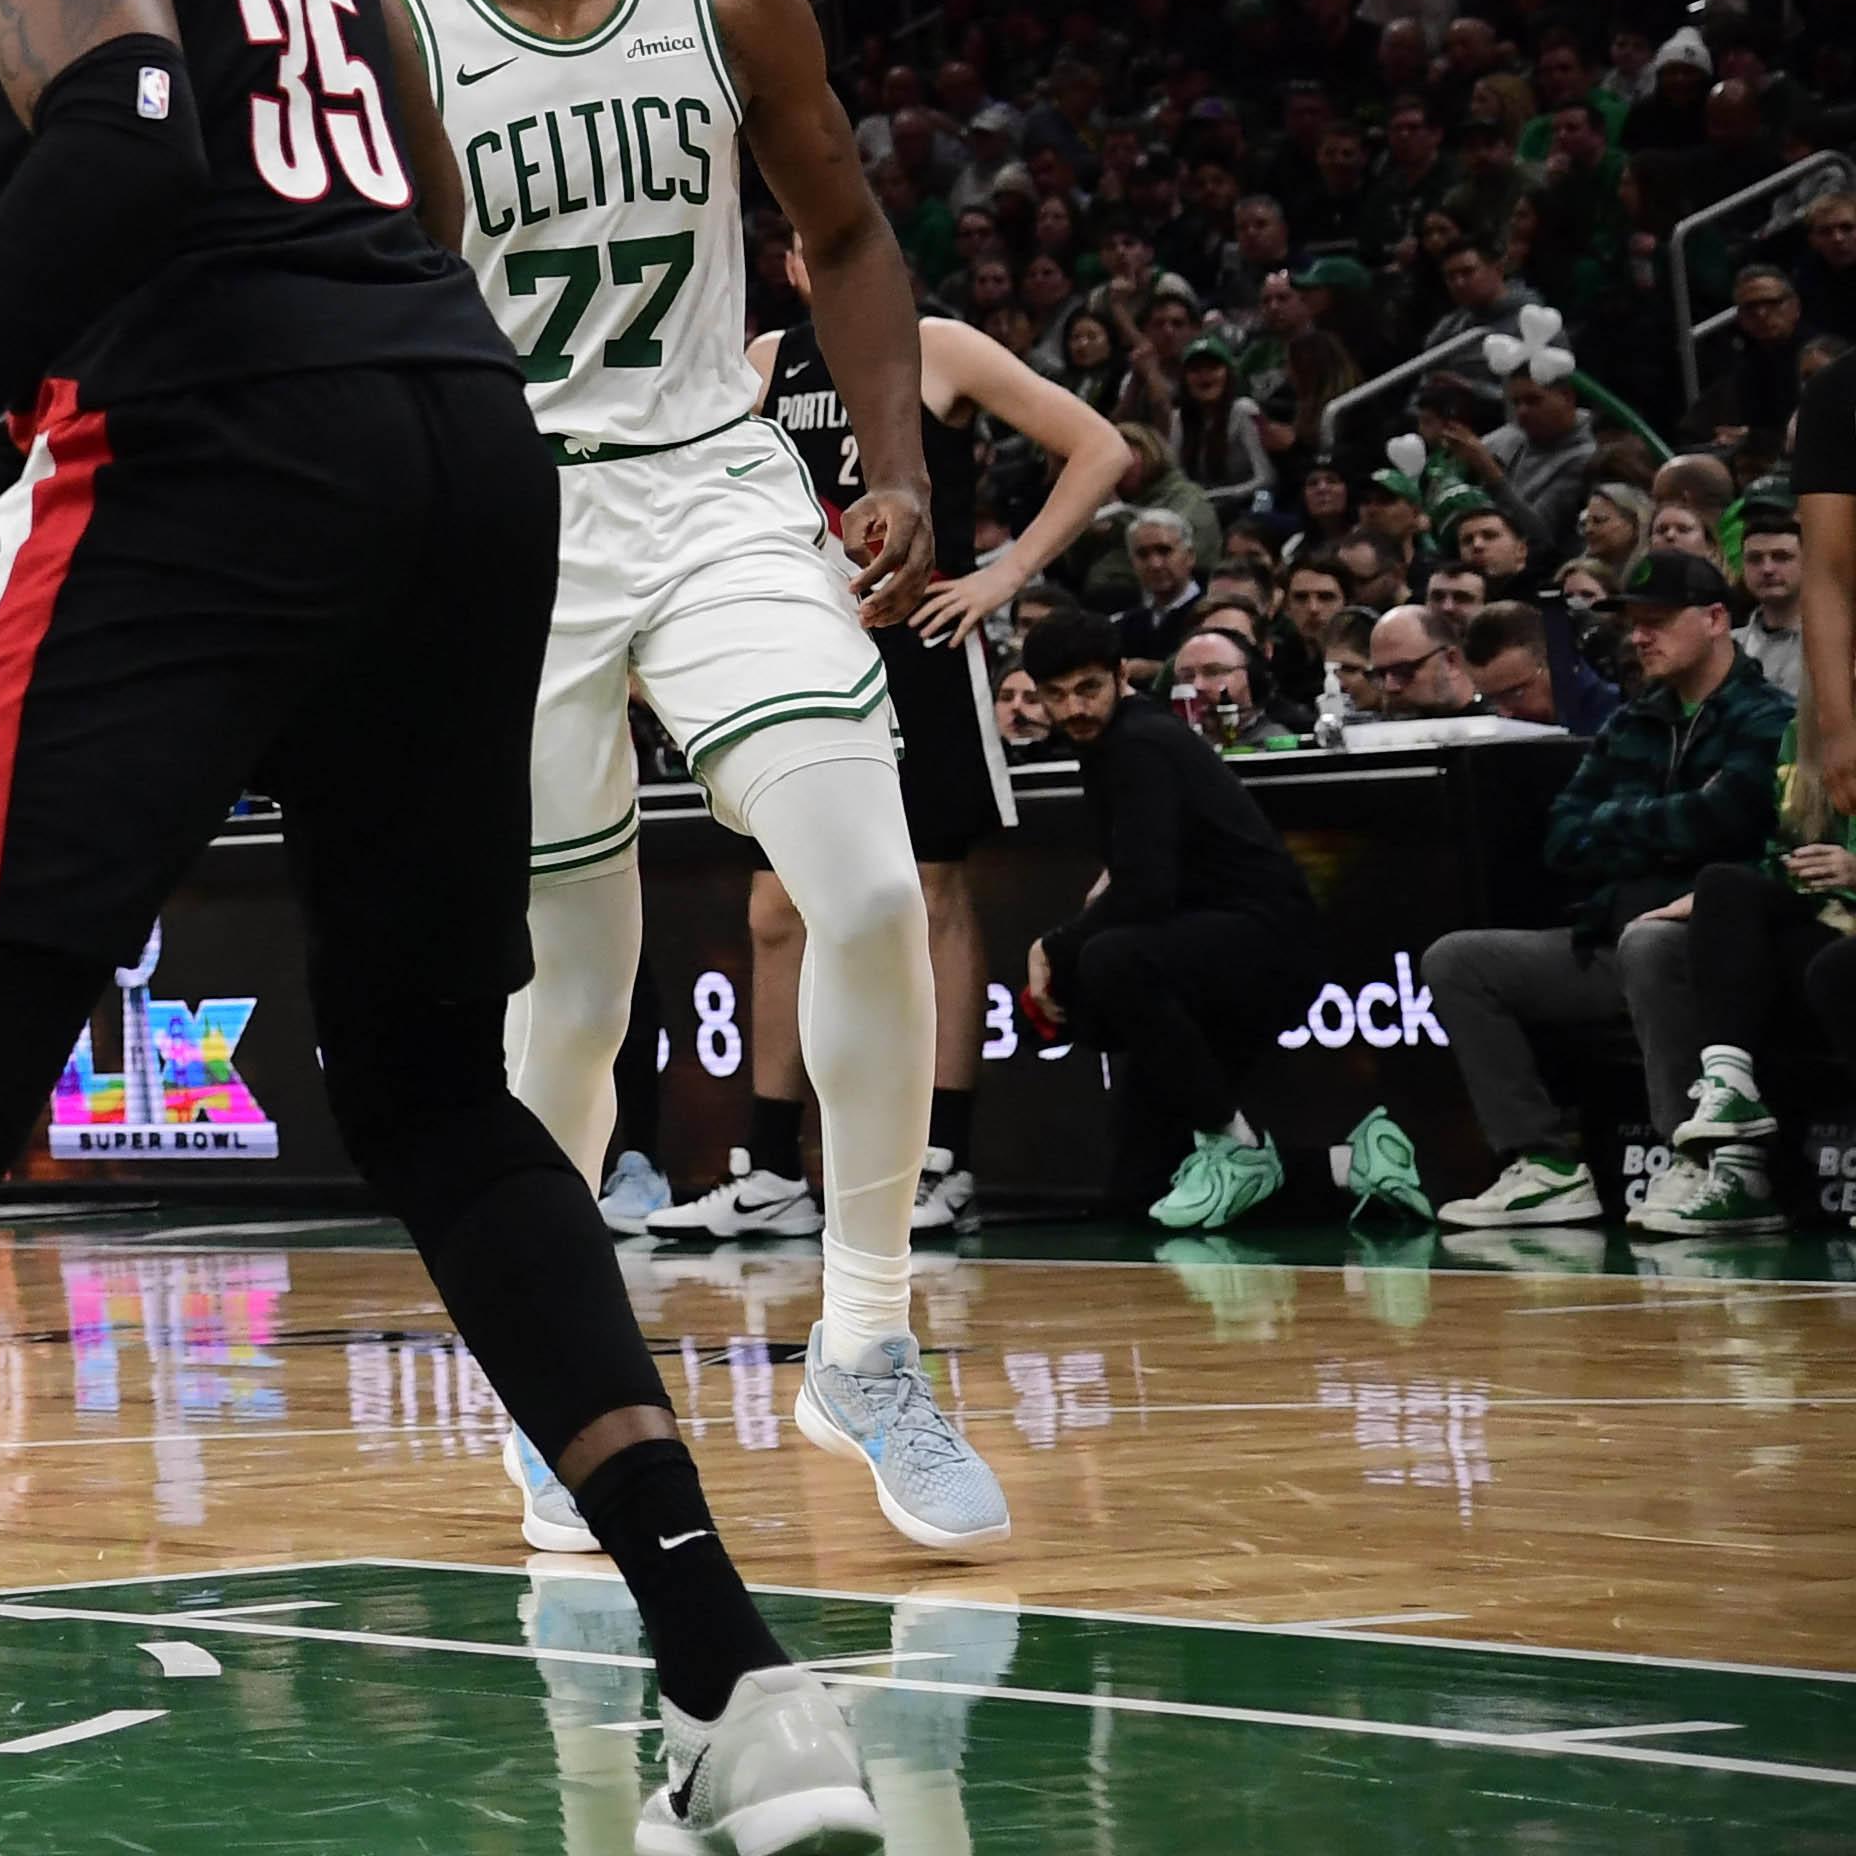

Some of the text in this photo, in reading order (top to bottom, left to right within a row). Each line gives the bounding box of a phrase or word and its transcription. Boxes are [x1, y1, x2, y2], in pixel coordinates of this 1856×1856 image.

[626, 34, 696, 61] Amica
[466, 96, 712, 238] CELTICS
[504, 230, 695, 384] 77
[777, 390, 850, 431] PORTL
[838, 435, 859, 486] 2
[78, 1131, 249, 1152] SUPER BOWL
